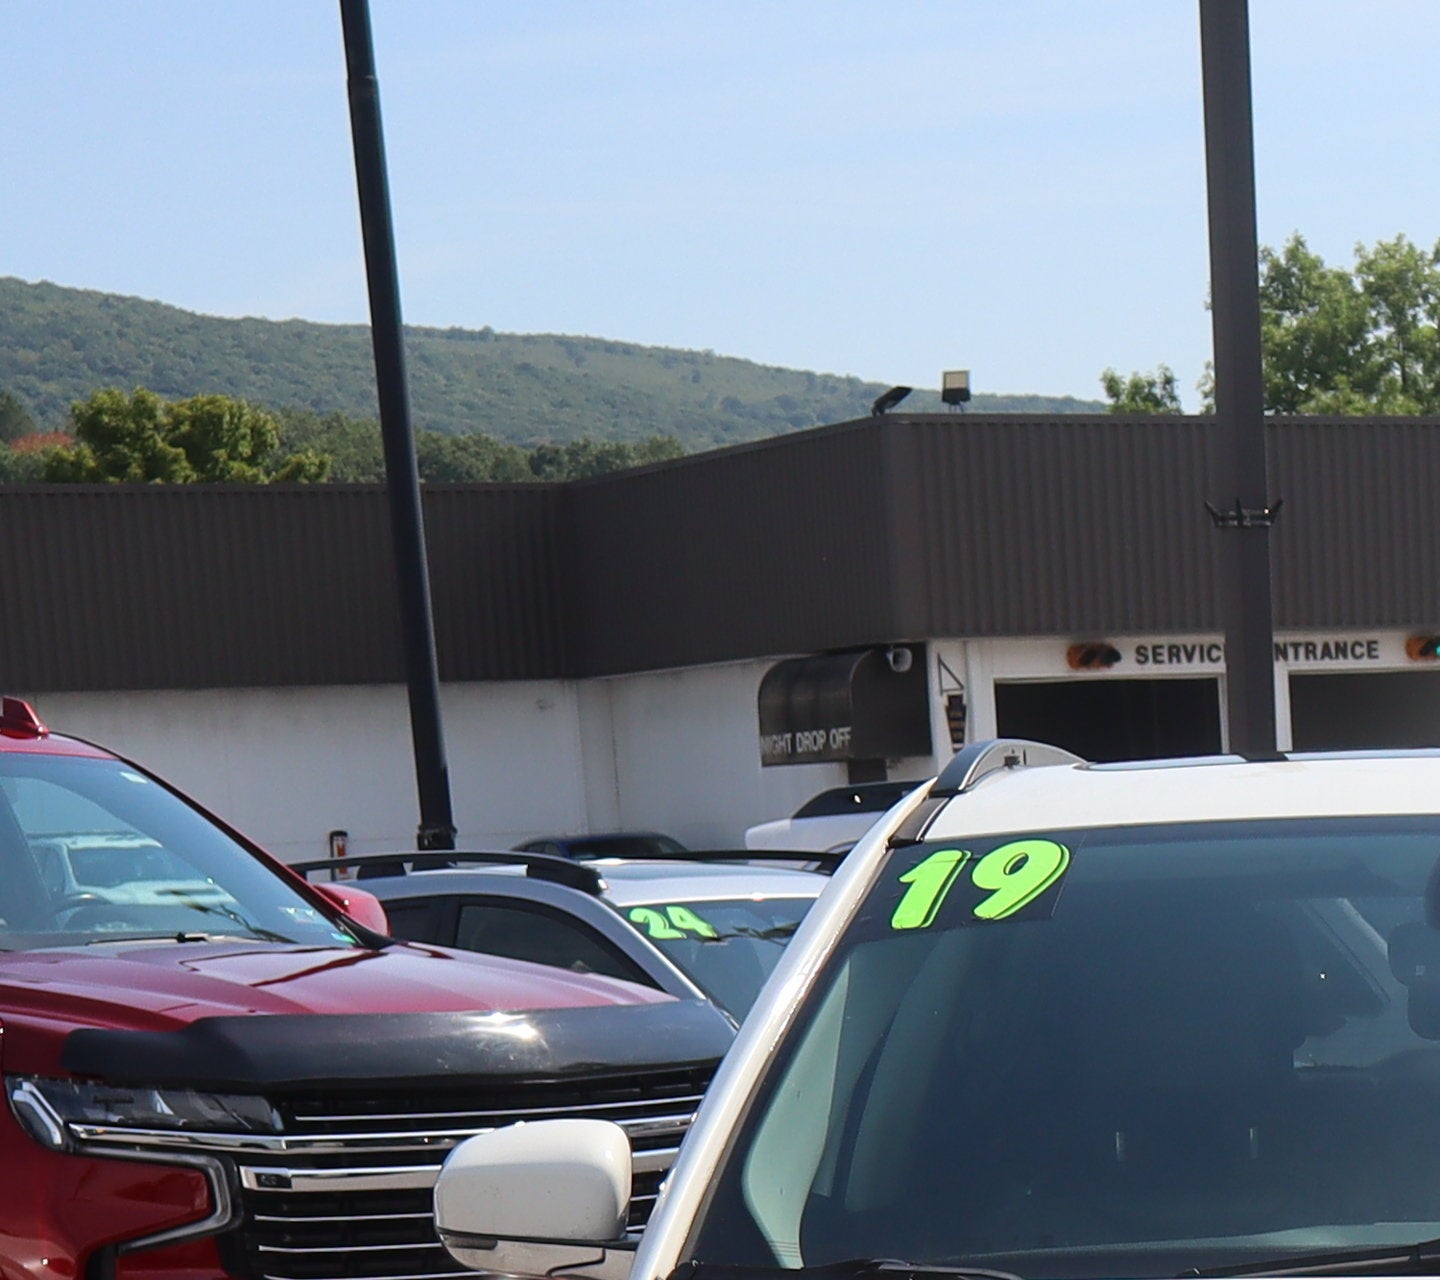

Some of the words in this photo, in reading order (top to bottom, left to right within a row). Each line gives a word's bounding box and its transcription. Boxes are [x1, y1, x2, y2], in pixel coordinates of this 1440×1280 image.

[1135, 644, 1224, 665] SERVIC
[1273, 640, 1380, 661] NTRANCE
[795, 729, 827, 753] DROP
[829, 726, 852, 749] OFF
[890, 838, 1071, 931] 19
[628, 905, 718, 940] 24
